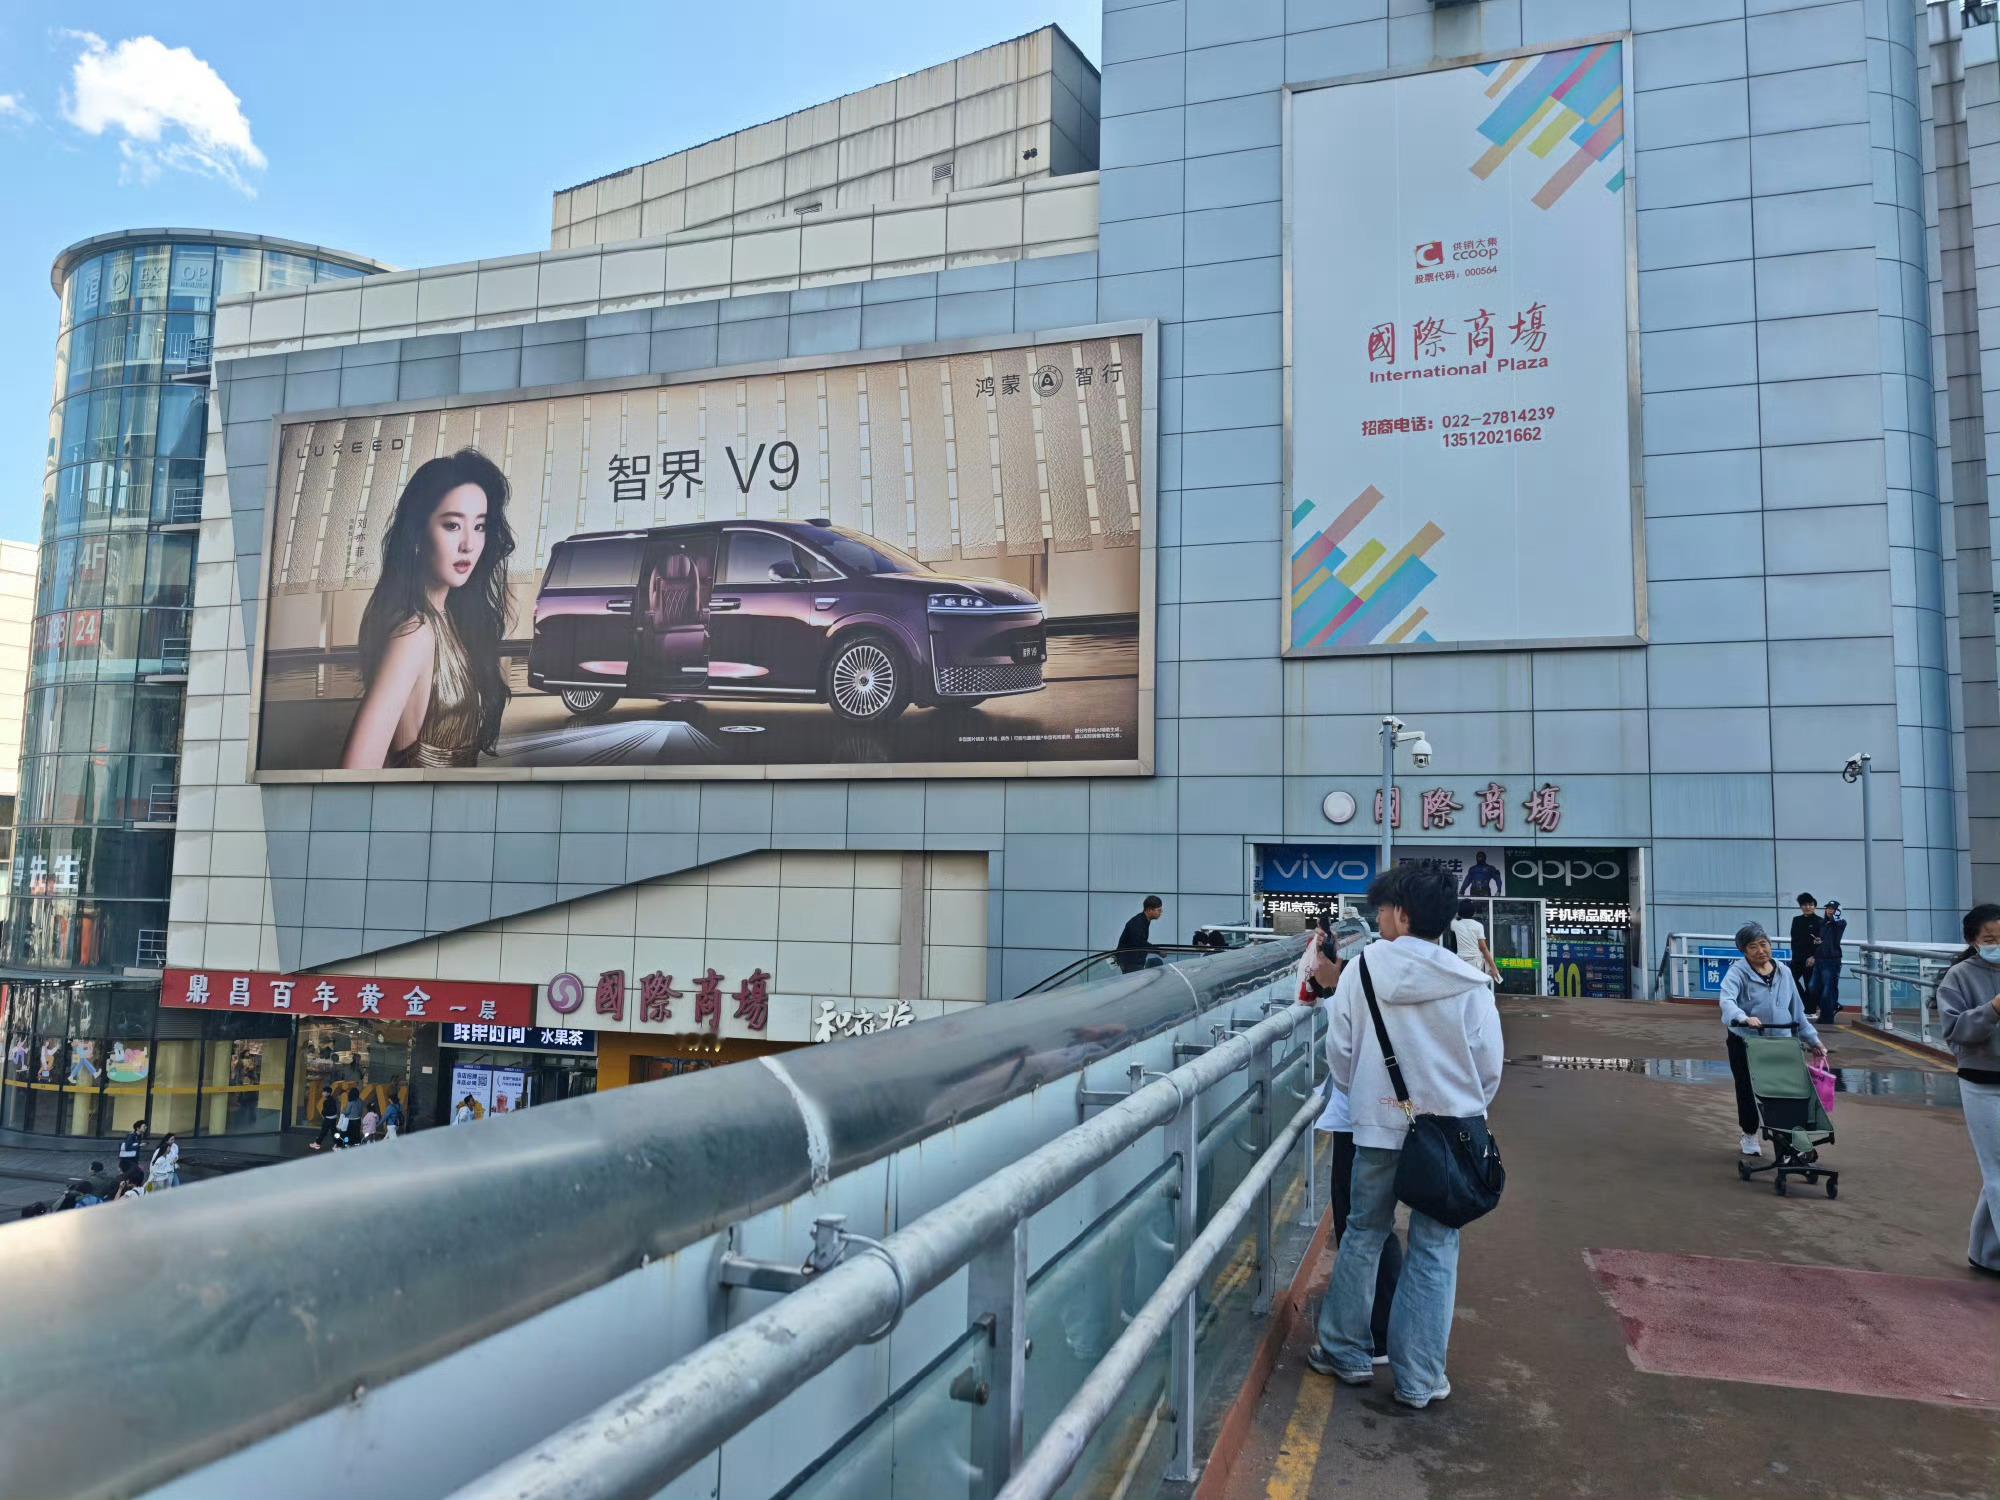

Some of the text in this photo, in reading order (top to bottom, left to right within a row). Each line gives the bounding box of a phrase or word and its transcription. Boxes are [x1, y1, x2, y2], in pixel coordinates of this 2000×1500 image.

[1453, 237, 1498, 251] 供销大集
[1465, 265, 1497, 277] 000564
[975, 374, 1021, 398] 鸿蒙
[1075, 363, 1122, 387] 智行
[1369, 357, 1549, 383] International Plaza
[1442, 406, 1555, 428] 022-27814239
[1442, 426, 1542, 447] 13512021662
[297, 438, 404, 459] LUXEED
[608, 440, 800, 502] 智界 V9
[353, 518, 368, 558] 刘亦菲
[1272, 853, 1369, 880] vivo
[1545, 908, 1628, 923] 手机精品配件
[541, 1028, 584, 1046] 水果茶
